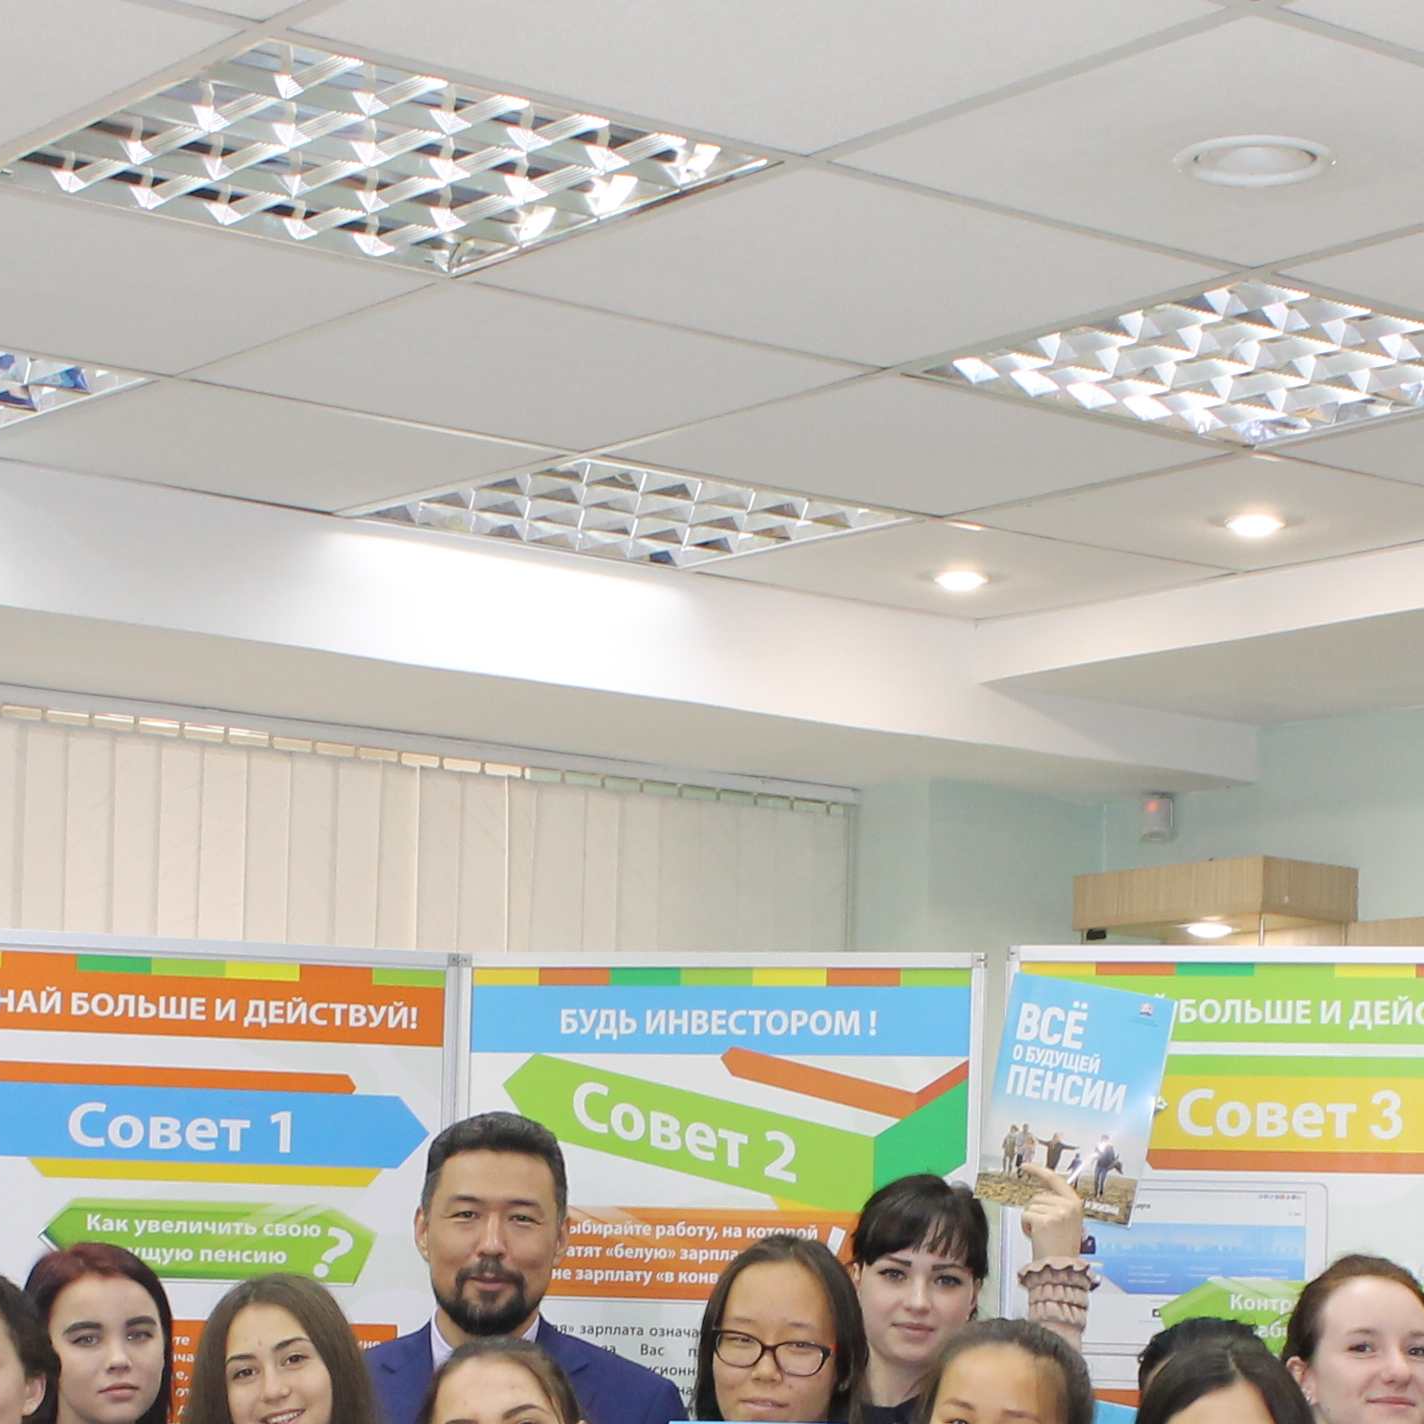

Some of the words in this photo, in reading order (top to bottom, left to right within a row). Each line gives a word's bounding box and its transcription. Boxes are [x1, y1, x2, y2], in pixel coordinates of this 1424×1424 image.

[70, 993, 206, 1021] БОЛЬШЕ
[215, 1000, 236, 1022] И
[244, 996, 419, 1030] ДЕЙСТВУЙ!
[560, 1009, 637, 1041] БУДЬ
[645, 1009, 860, 1036] ИНВЕСТОРОМ
[1015, 1001, 1088, 1050] ВСЁ
[1179, 998, 1312, 1025] БОЛЬШЕ
[1321, 1000, 1342, 1025] И
[1013, 1045, 1023, 1061] О
[1026, 1046, 1100, 1074] БУДУЩЕЙ
[1006, 1065, 1127, 1113] ПЕНСИИ
[68, 1101, 250, 1151] Совет
[269, 1111, 294, 1153] 1
[1178, 1088, 1358, 1140] Совет
[1372, 1090, 1403, 1139] 3
[573, 1082, 748, 1168] Совет
[765, 1131, 797, 1183] 2
[86, 1213, 128, 1232] Как
[134, 1217, 258, 1239] увеличить
[263, 1222, 322, 1238] свою
[569, 1219, 651, 1237] ыбирайте
[655, 1222, 718, 1240] работу,
[723, 1227, 742, 1238] на
[129, 1247, 194, 1268] ущую
[199, 1249, 287, 1266] пенсию
[566, 1246, 602, 1258] атят
[605, 1244, 676, 1260] «белую»
[552, 1269, 571, 1279] не
[575, 1270, 653, 1285] зарплату
[656, 1271, 674, 1283] «в
[580, 1325, 645, 1338] зарплата
[650, 1328, 699, 1338] означа
[640, 1345, 665, 1356] Вас
